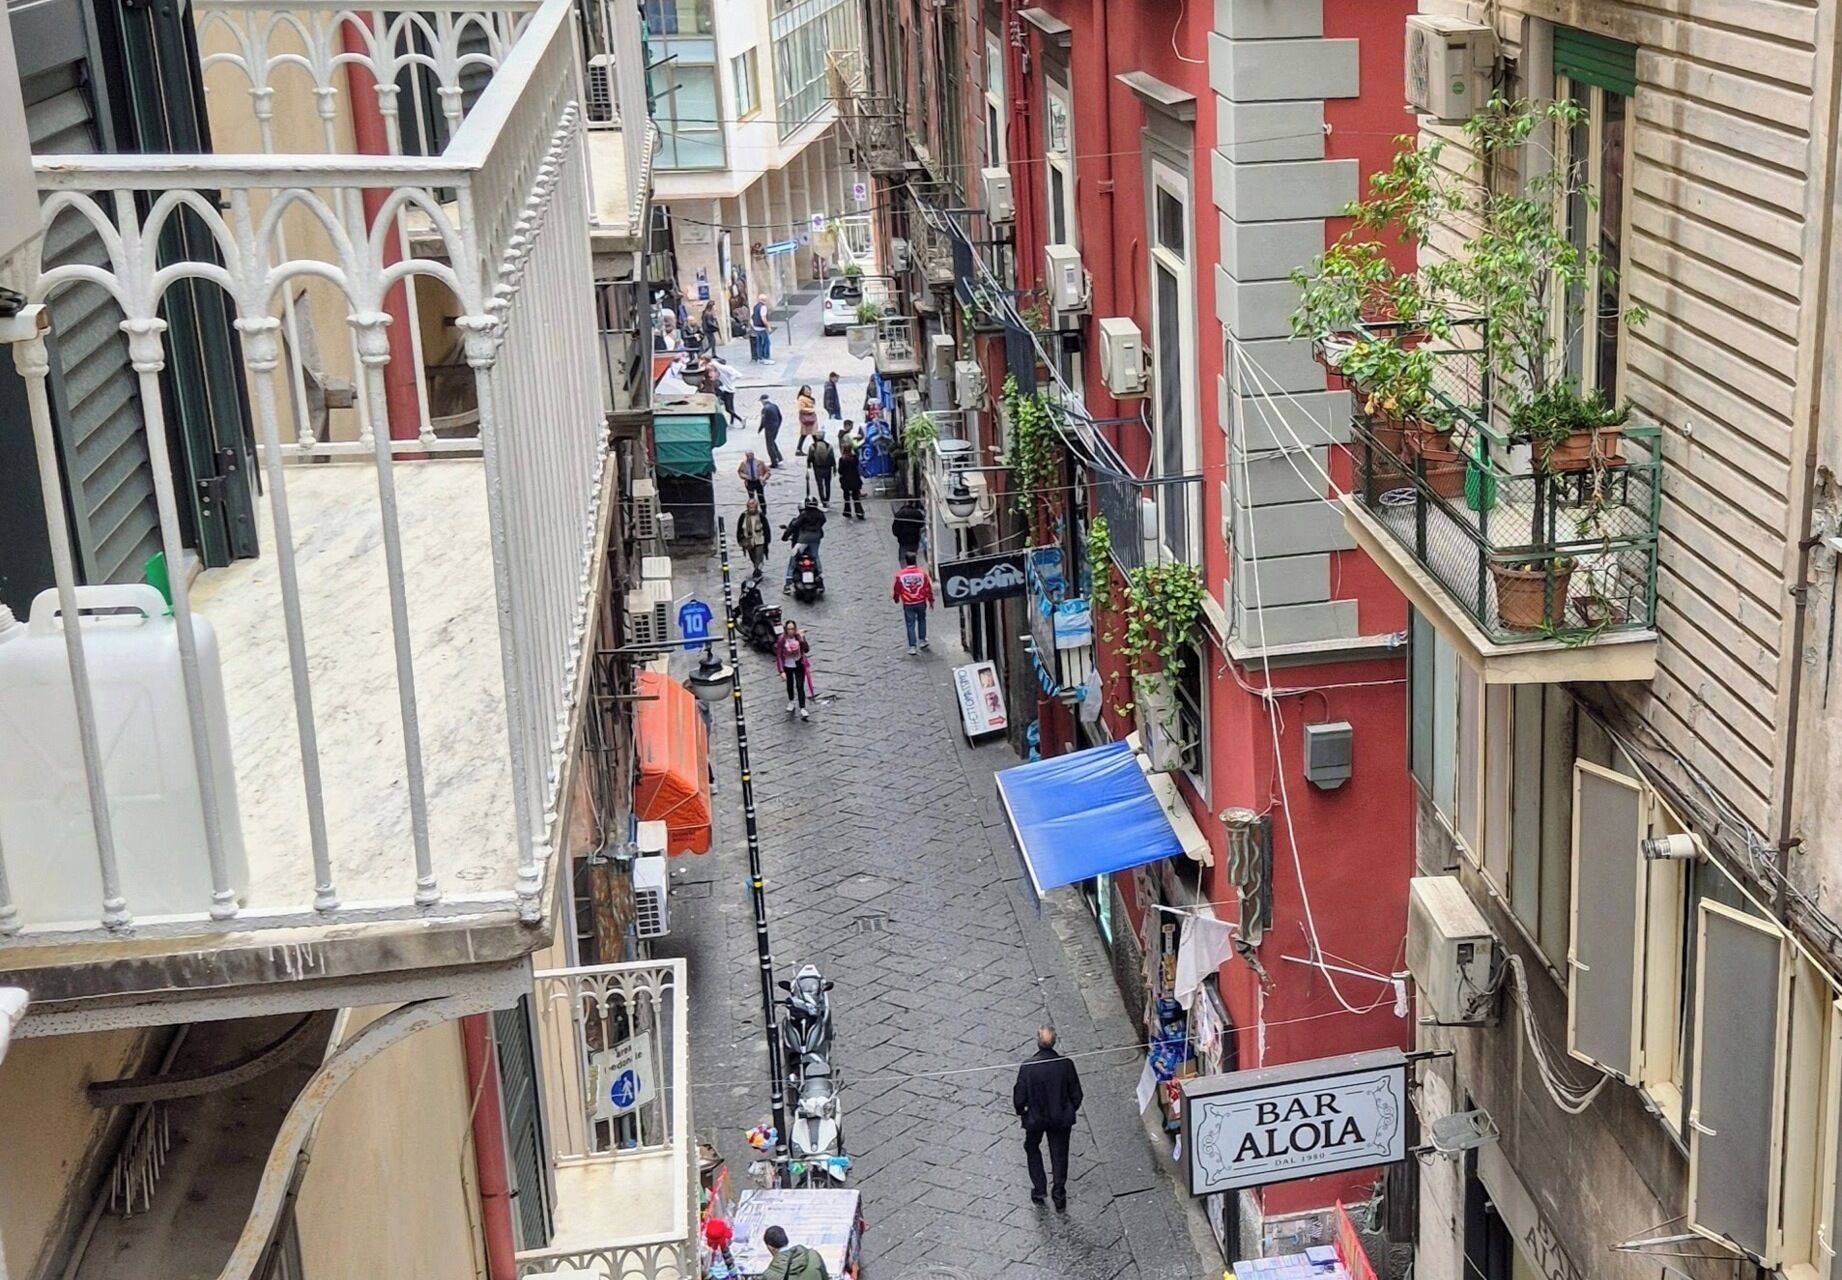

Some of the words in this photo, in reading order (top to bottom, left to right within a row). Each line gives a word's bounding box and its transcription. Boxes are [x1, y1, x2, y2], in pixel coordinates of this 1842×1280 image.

[685, 613, 704, 634] 10
[604, 1051, 643, 1073] edonle
[1255, 1092, 1342, 1127] BAR
[1232, 1115, 1366, 1163] ALOIA
[1274, 1155, 1296, 1167] DAL
[1301, 1152, 1326, 1164] 1980
